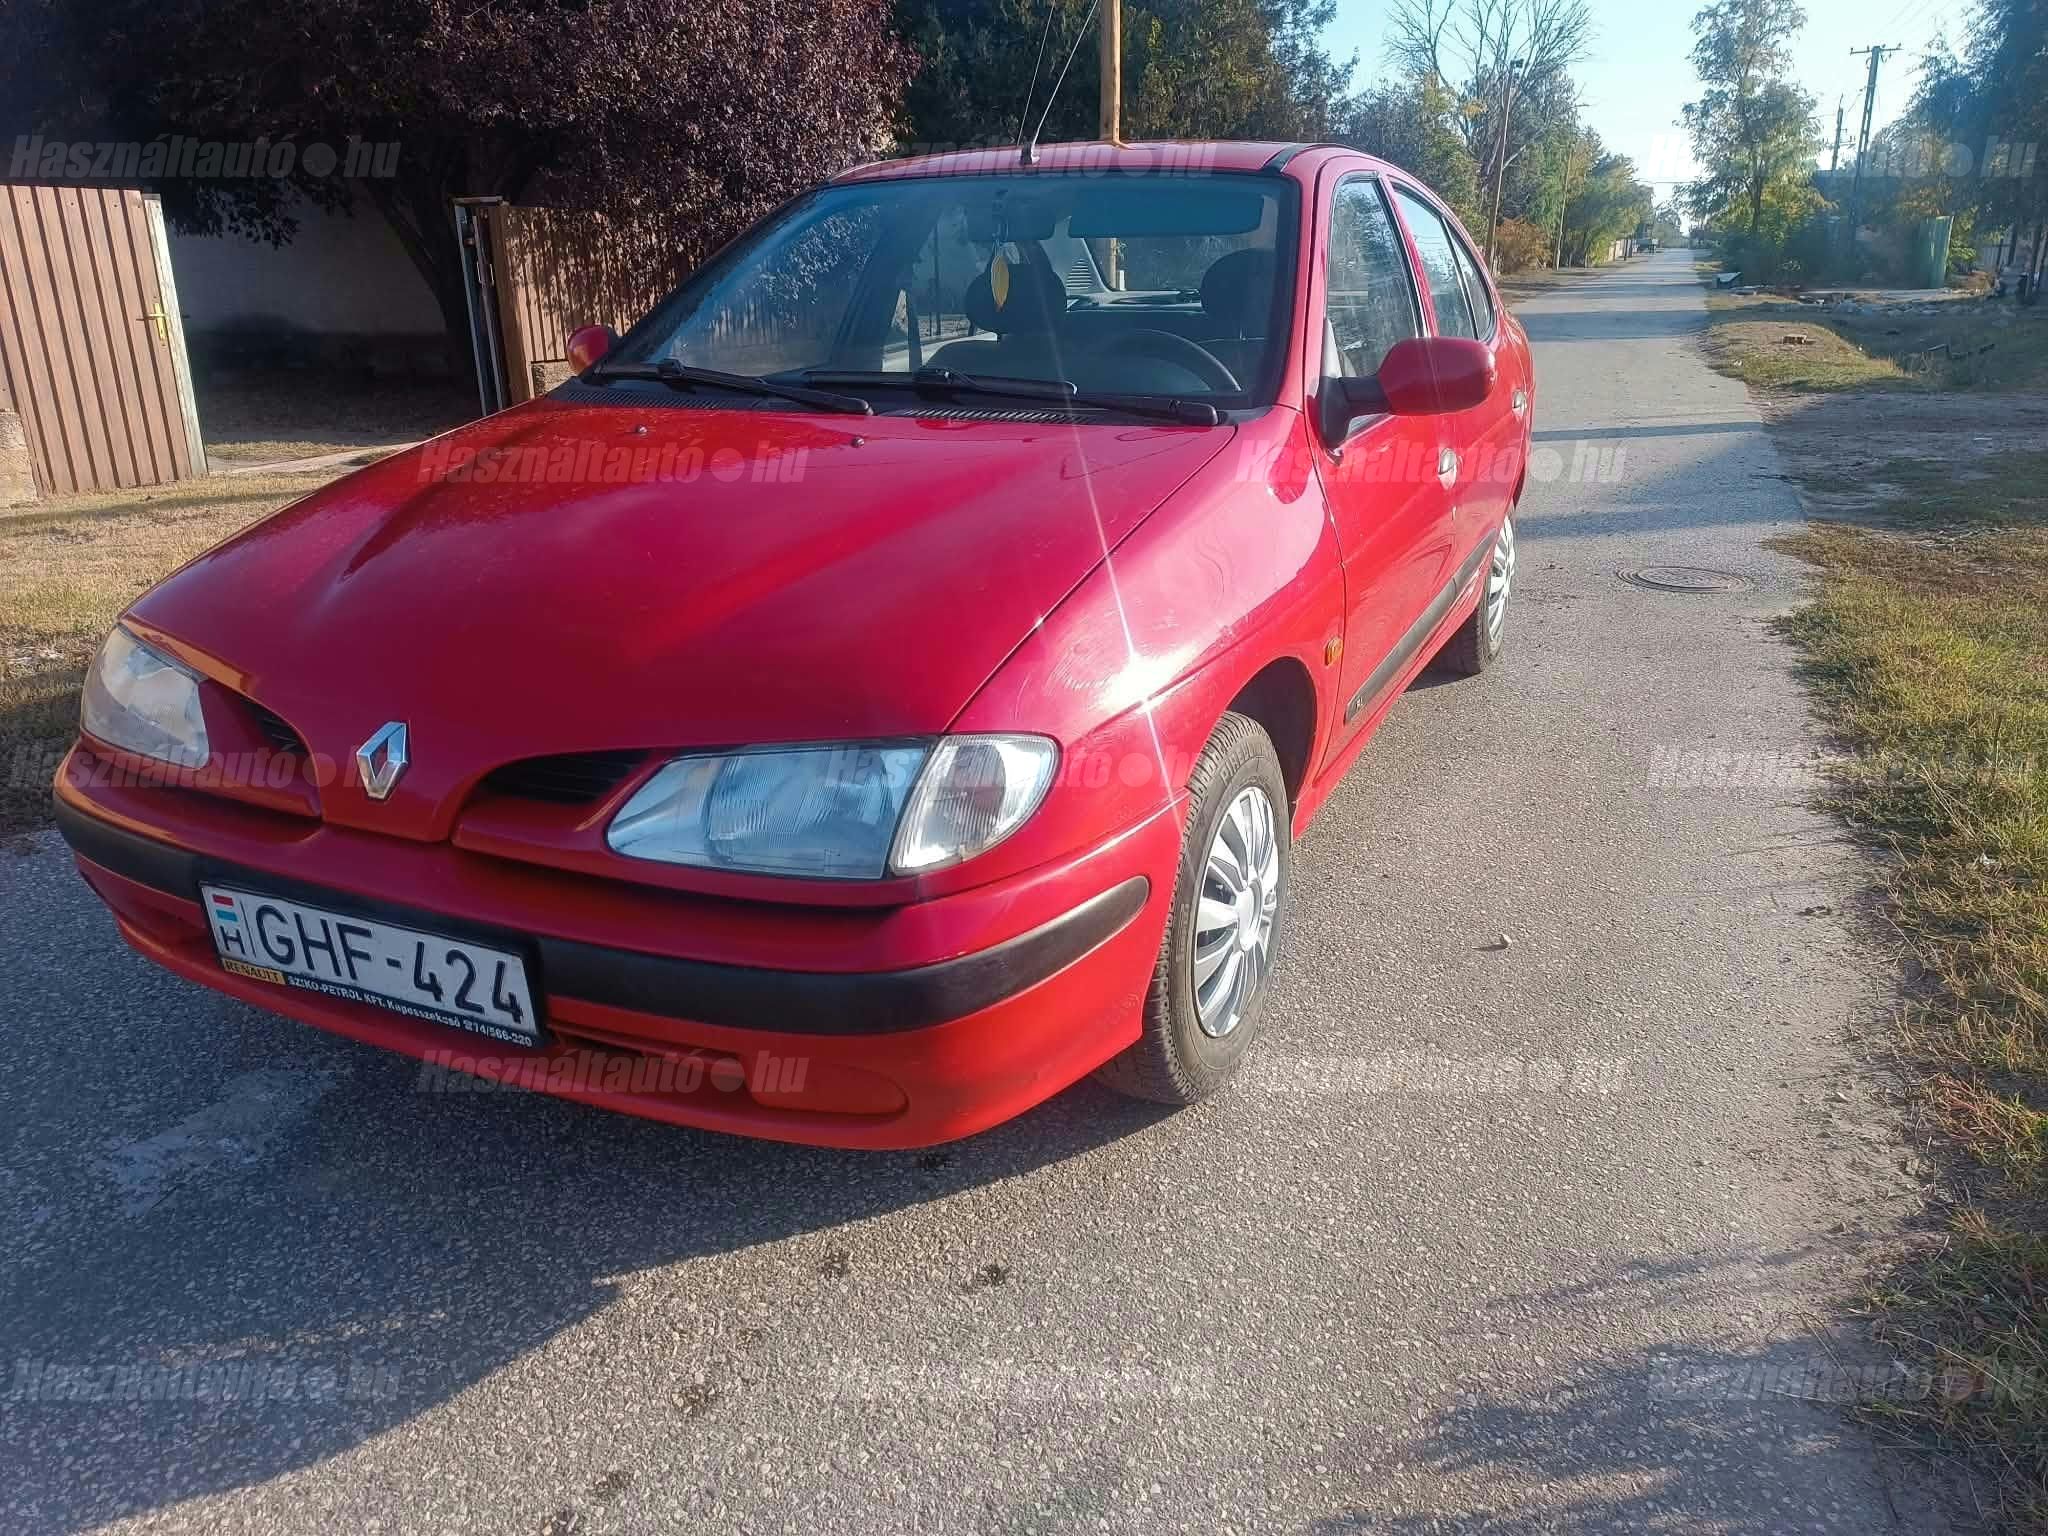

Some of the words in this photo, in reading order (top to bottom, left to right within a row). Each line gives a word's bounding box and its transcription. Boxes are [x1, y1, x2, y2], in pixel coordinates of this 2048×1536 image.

[219, 924, 246, 956] H
[255, 904, 525, 1024] GHF-424
[224, 959, 281, 984] RENAULT
